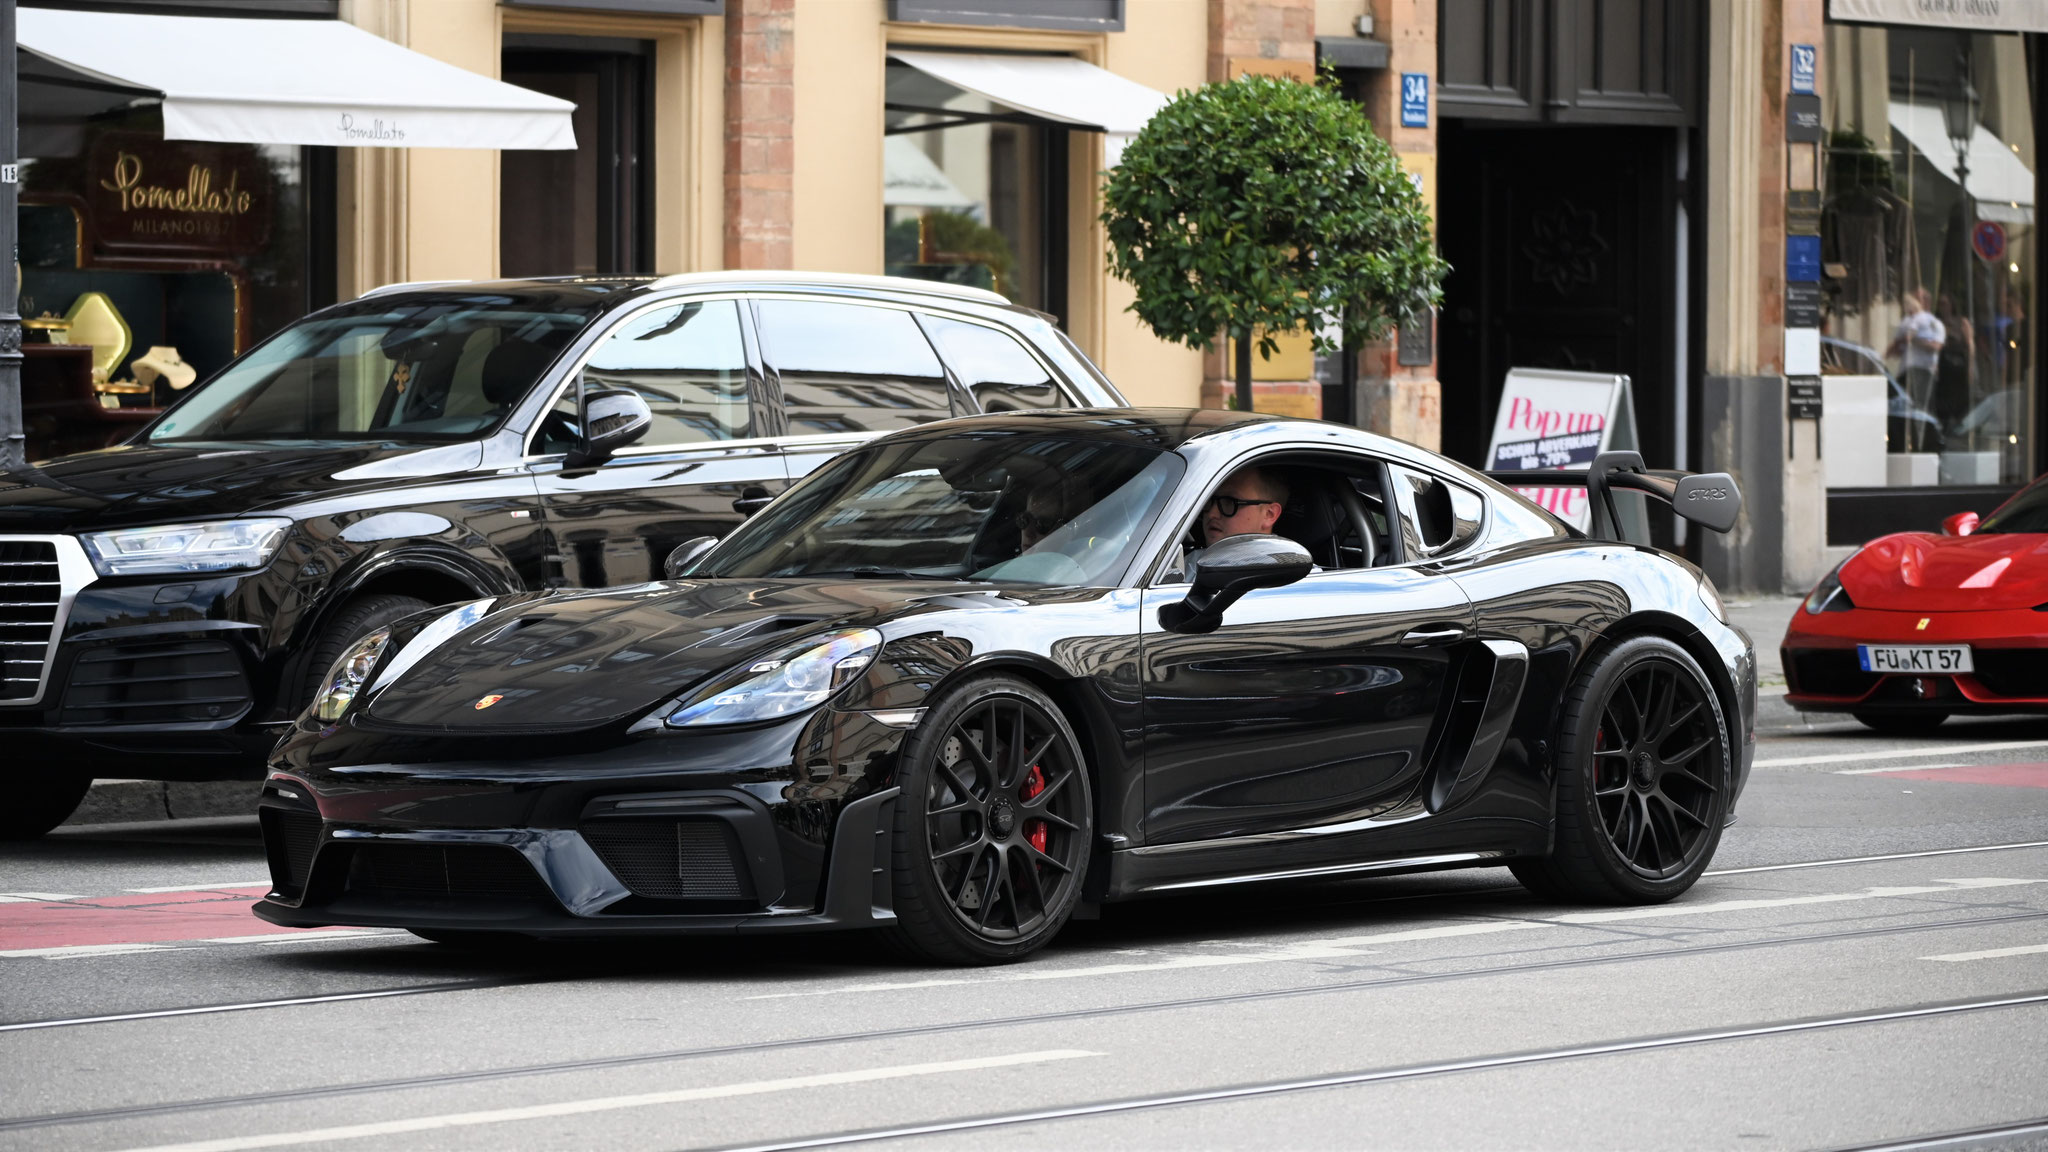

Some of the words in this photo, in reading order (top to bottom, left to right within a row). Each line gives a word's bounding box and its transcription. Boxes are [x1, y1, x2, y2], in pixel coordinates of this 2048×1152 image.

[1796, 48, 1814, 73] 32
[1405, 76, 1425, 102] 34
[337, 113, 405, 140] Pomellato
[101, 152, 251, 215] Pomellato
[1508, 397, 1561, 438] Pop
[1565, 411, 1605, 434] up
[1874, 649, 1900, 669] FÜ
[1909, 649, 1934, 669] KT
[1938, 649, 1962, 670] 57
